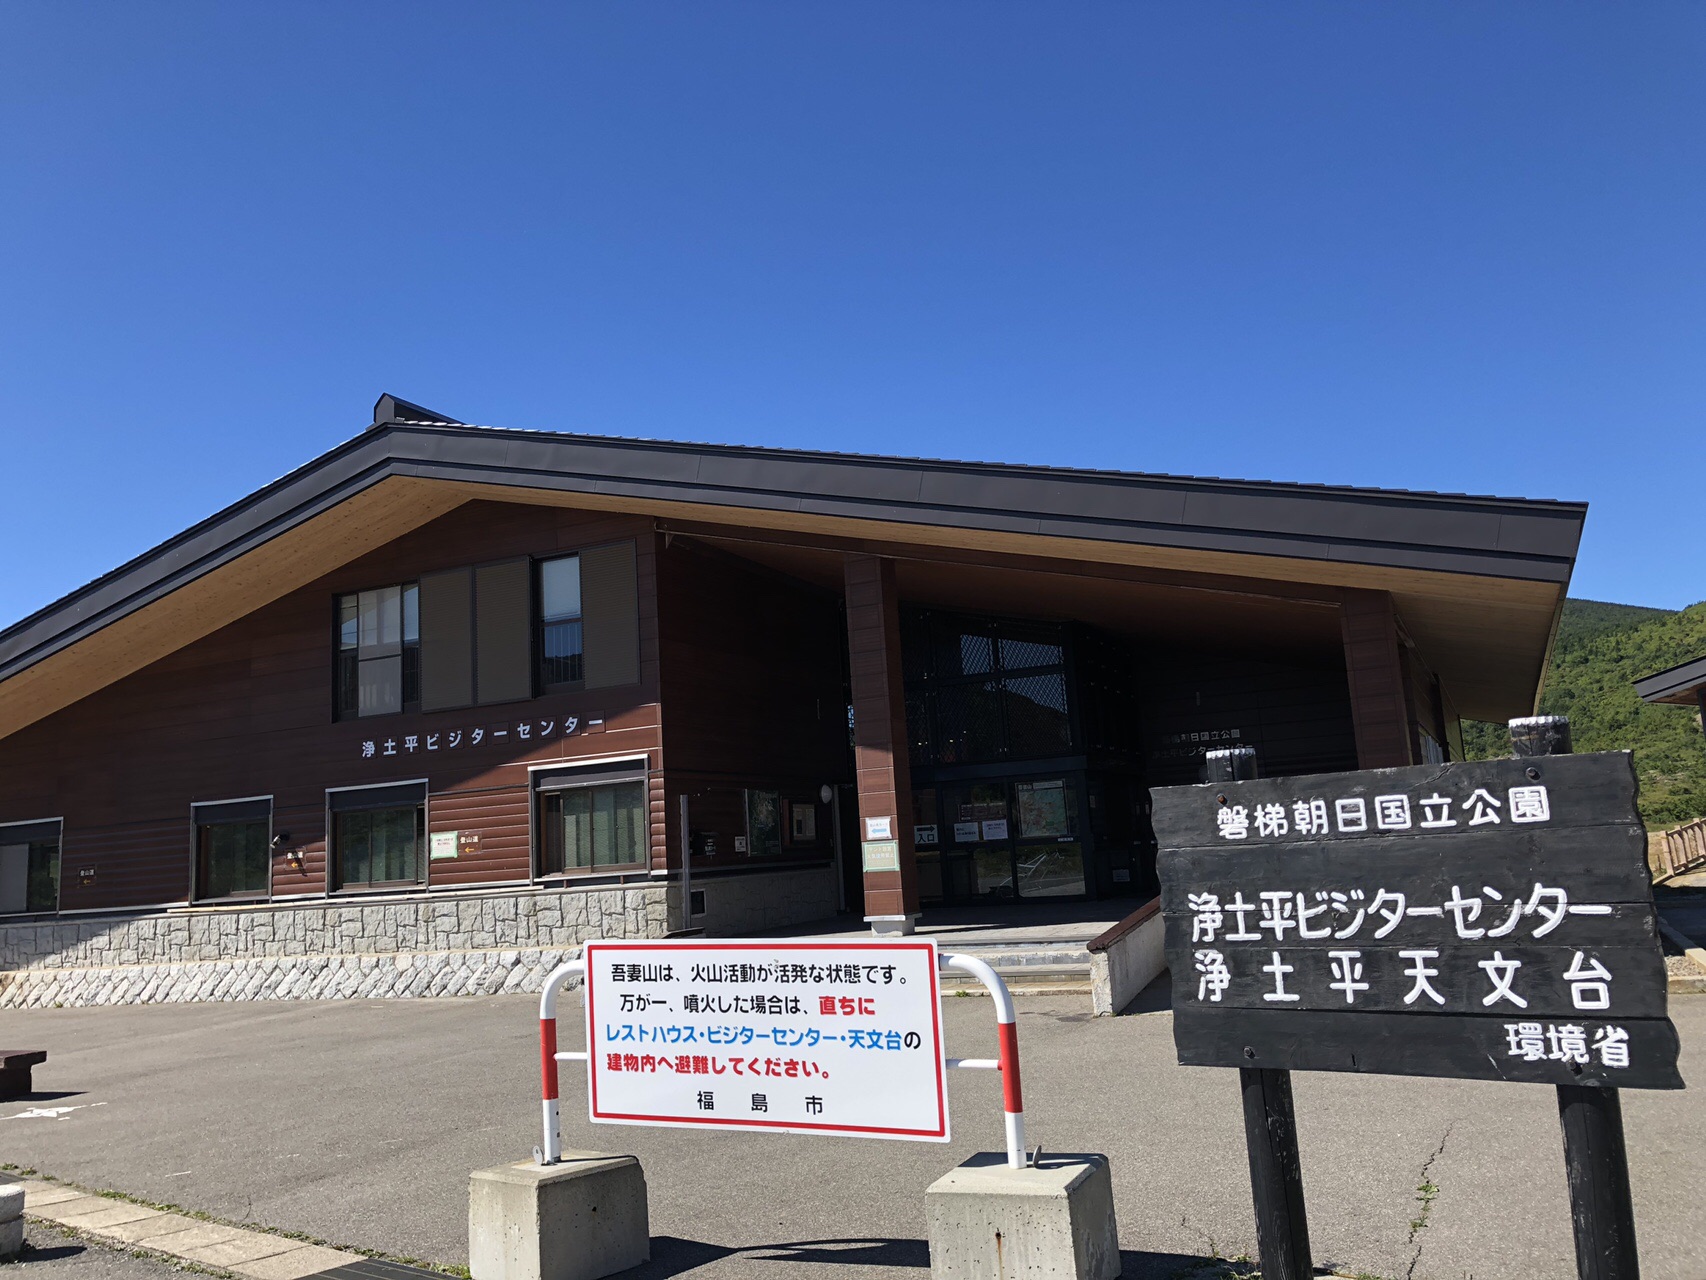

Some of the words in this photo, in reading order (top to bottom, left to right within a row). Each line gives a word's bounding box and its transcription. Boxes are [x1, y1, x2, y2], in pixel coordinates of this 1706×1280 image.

[362, 717, 603, 758] 浄土平ビジターセンター
[1217, 786, 1550, 840] 磐梯朝日国立公園
[917, 833, 935, 843] 入口
[1188, 882, 1612, 943] 浄土平ビジターセンター
[611, 963, 907, 985] 吾妻山は、火山活動が活発な状態です。
[619, 993, 876, 1016] 万が一、噴火した場合は、直ちに
[1504, 1023, 1630, 1067] 環境省
[606, 1053, 829, 1079] 建物内へ避難してください。
